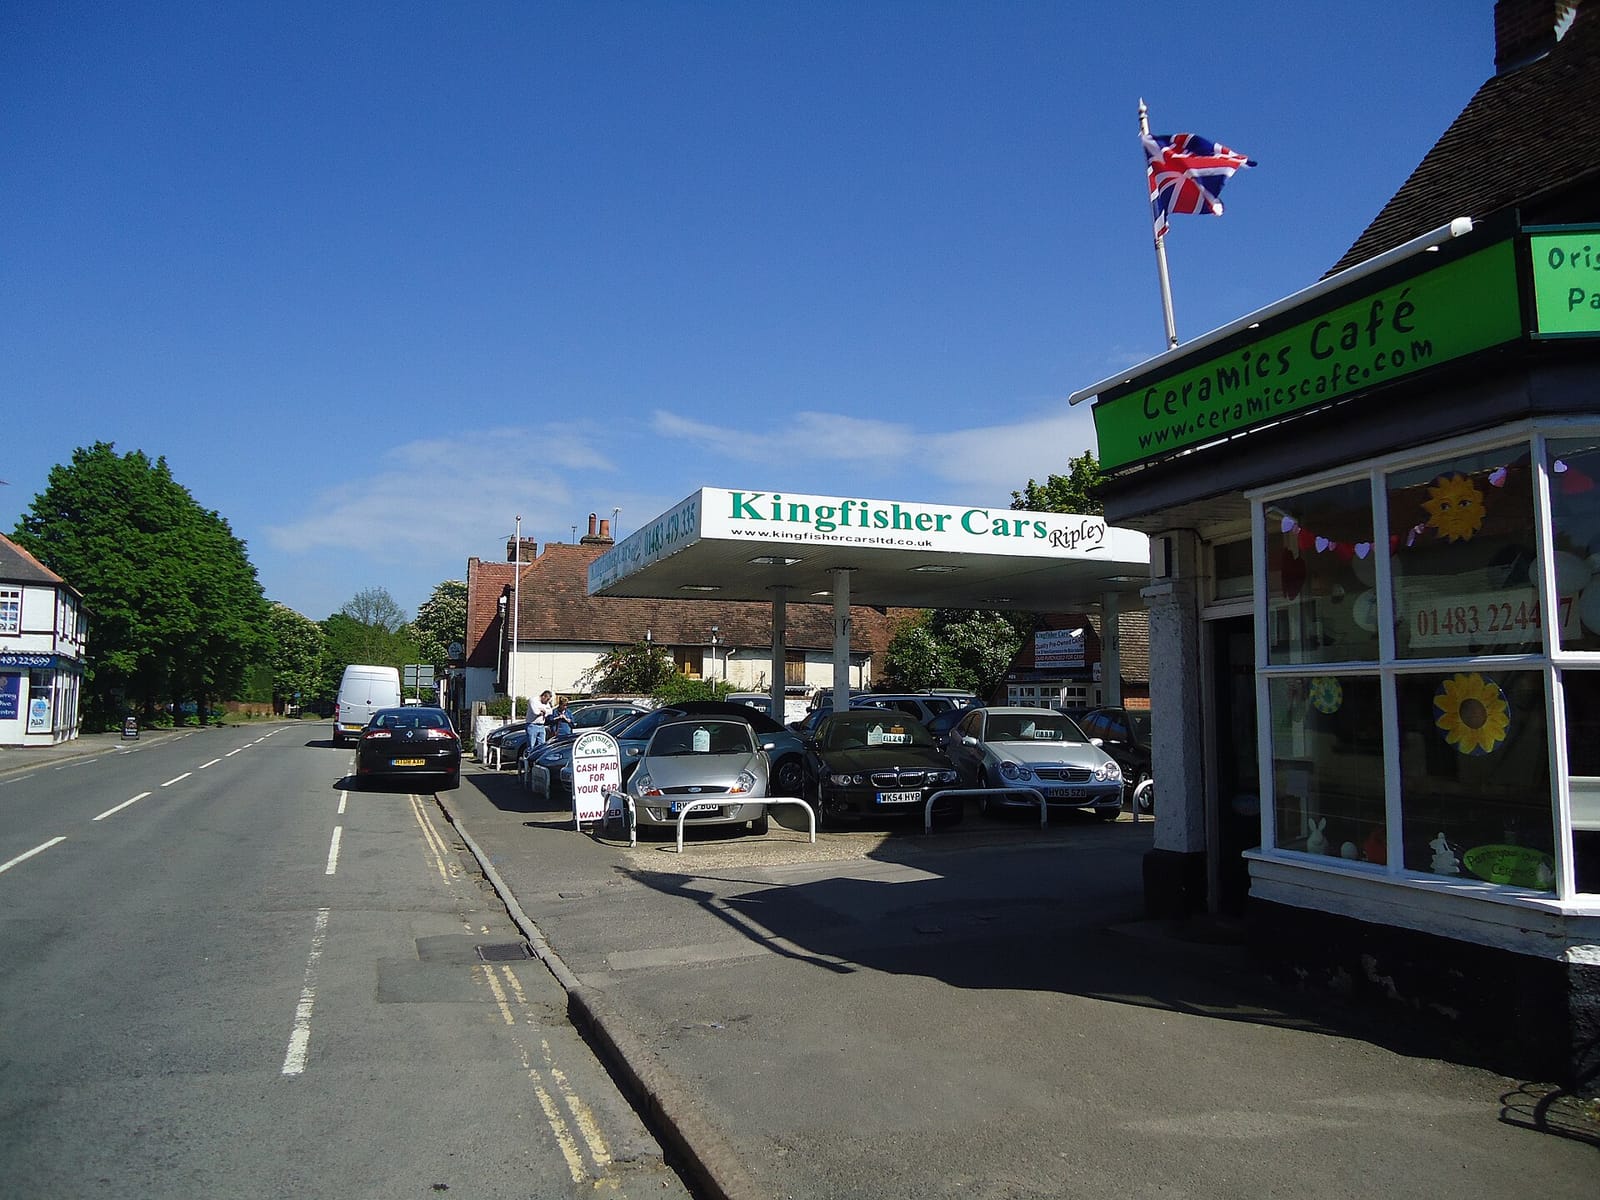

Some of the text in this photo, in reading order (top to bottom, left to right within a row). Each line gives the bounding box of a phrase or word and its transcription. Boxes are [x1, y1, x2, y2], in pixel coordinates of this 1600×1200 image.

[1143, 287, 1416, 420] Ceramics Café
[1139, 339, 1433, 449] www.ceramicscafe.com
[728, 491, 1047, 539] Kingfisher Cars
[644, 523, 664, 557] 01483
[731, 528, 933, 548] www.kingfishercarsltd.co.uk
[1048, 519, 1105, 549] Ripley
[1417, 597, 1573, 637] 01483 22447
[18, 656, 50, 667] 225699
[577, 735, 614, 752] KINGFISHER
[576, 762, 618, 773] CASH PAID
[589, 773, 605, 783] FOR
[577, 783, 618, 794] YOUR CAR
[881, 792, 921, 802] WK54 HVP
